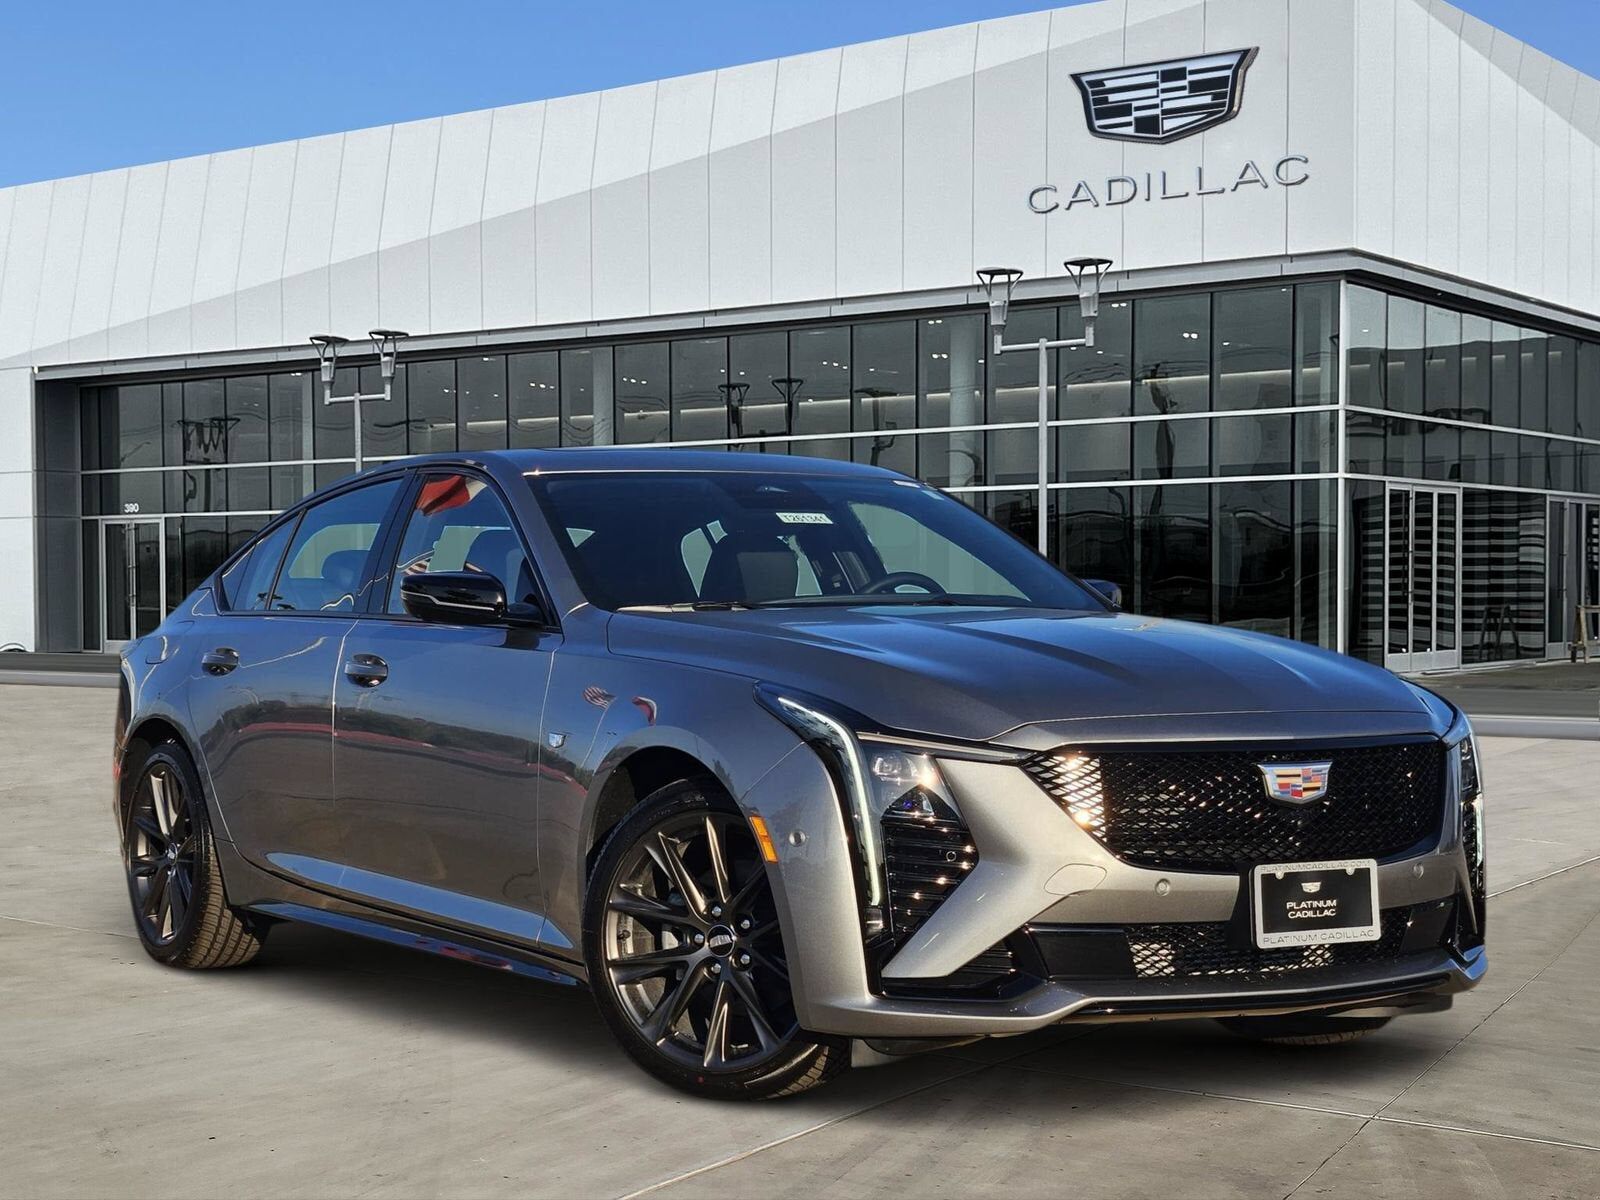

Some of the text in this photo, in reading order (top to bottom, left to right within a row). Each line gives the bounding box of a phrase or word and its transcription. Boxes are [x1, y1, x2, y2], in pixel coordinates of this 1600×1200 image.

[1028, 154, 1309, 214] CADILLAC
[124, 503, 139, 513] 390
[1286, 899, 1337, 910] PLATINUM
[1287, 908, 1336, 919] CADILLAC
[1263, 928, 1374, 944] PLATINUM CADILLAC
